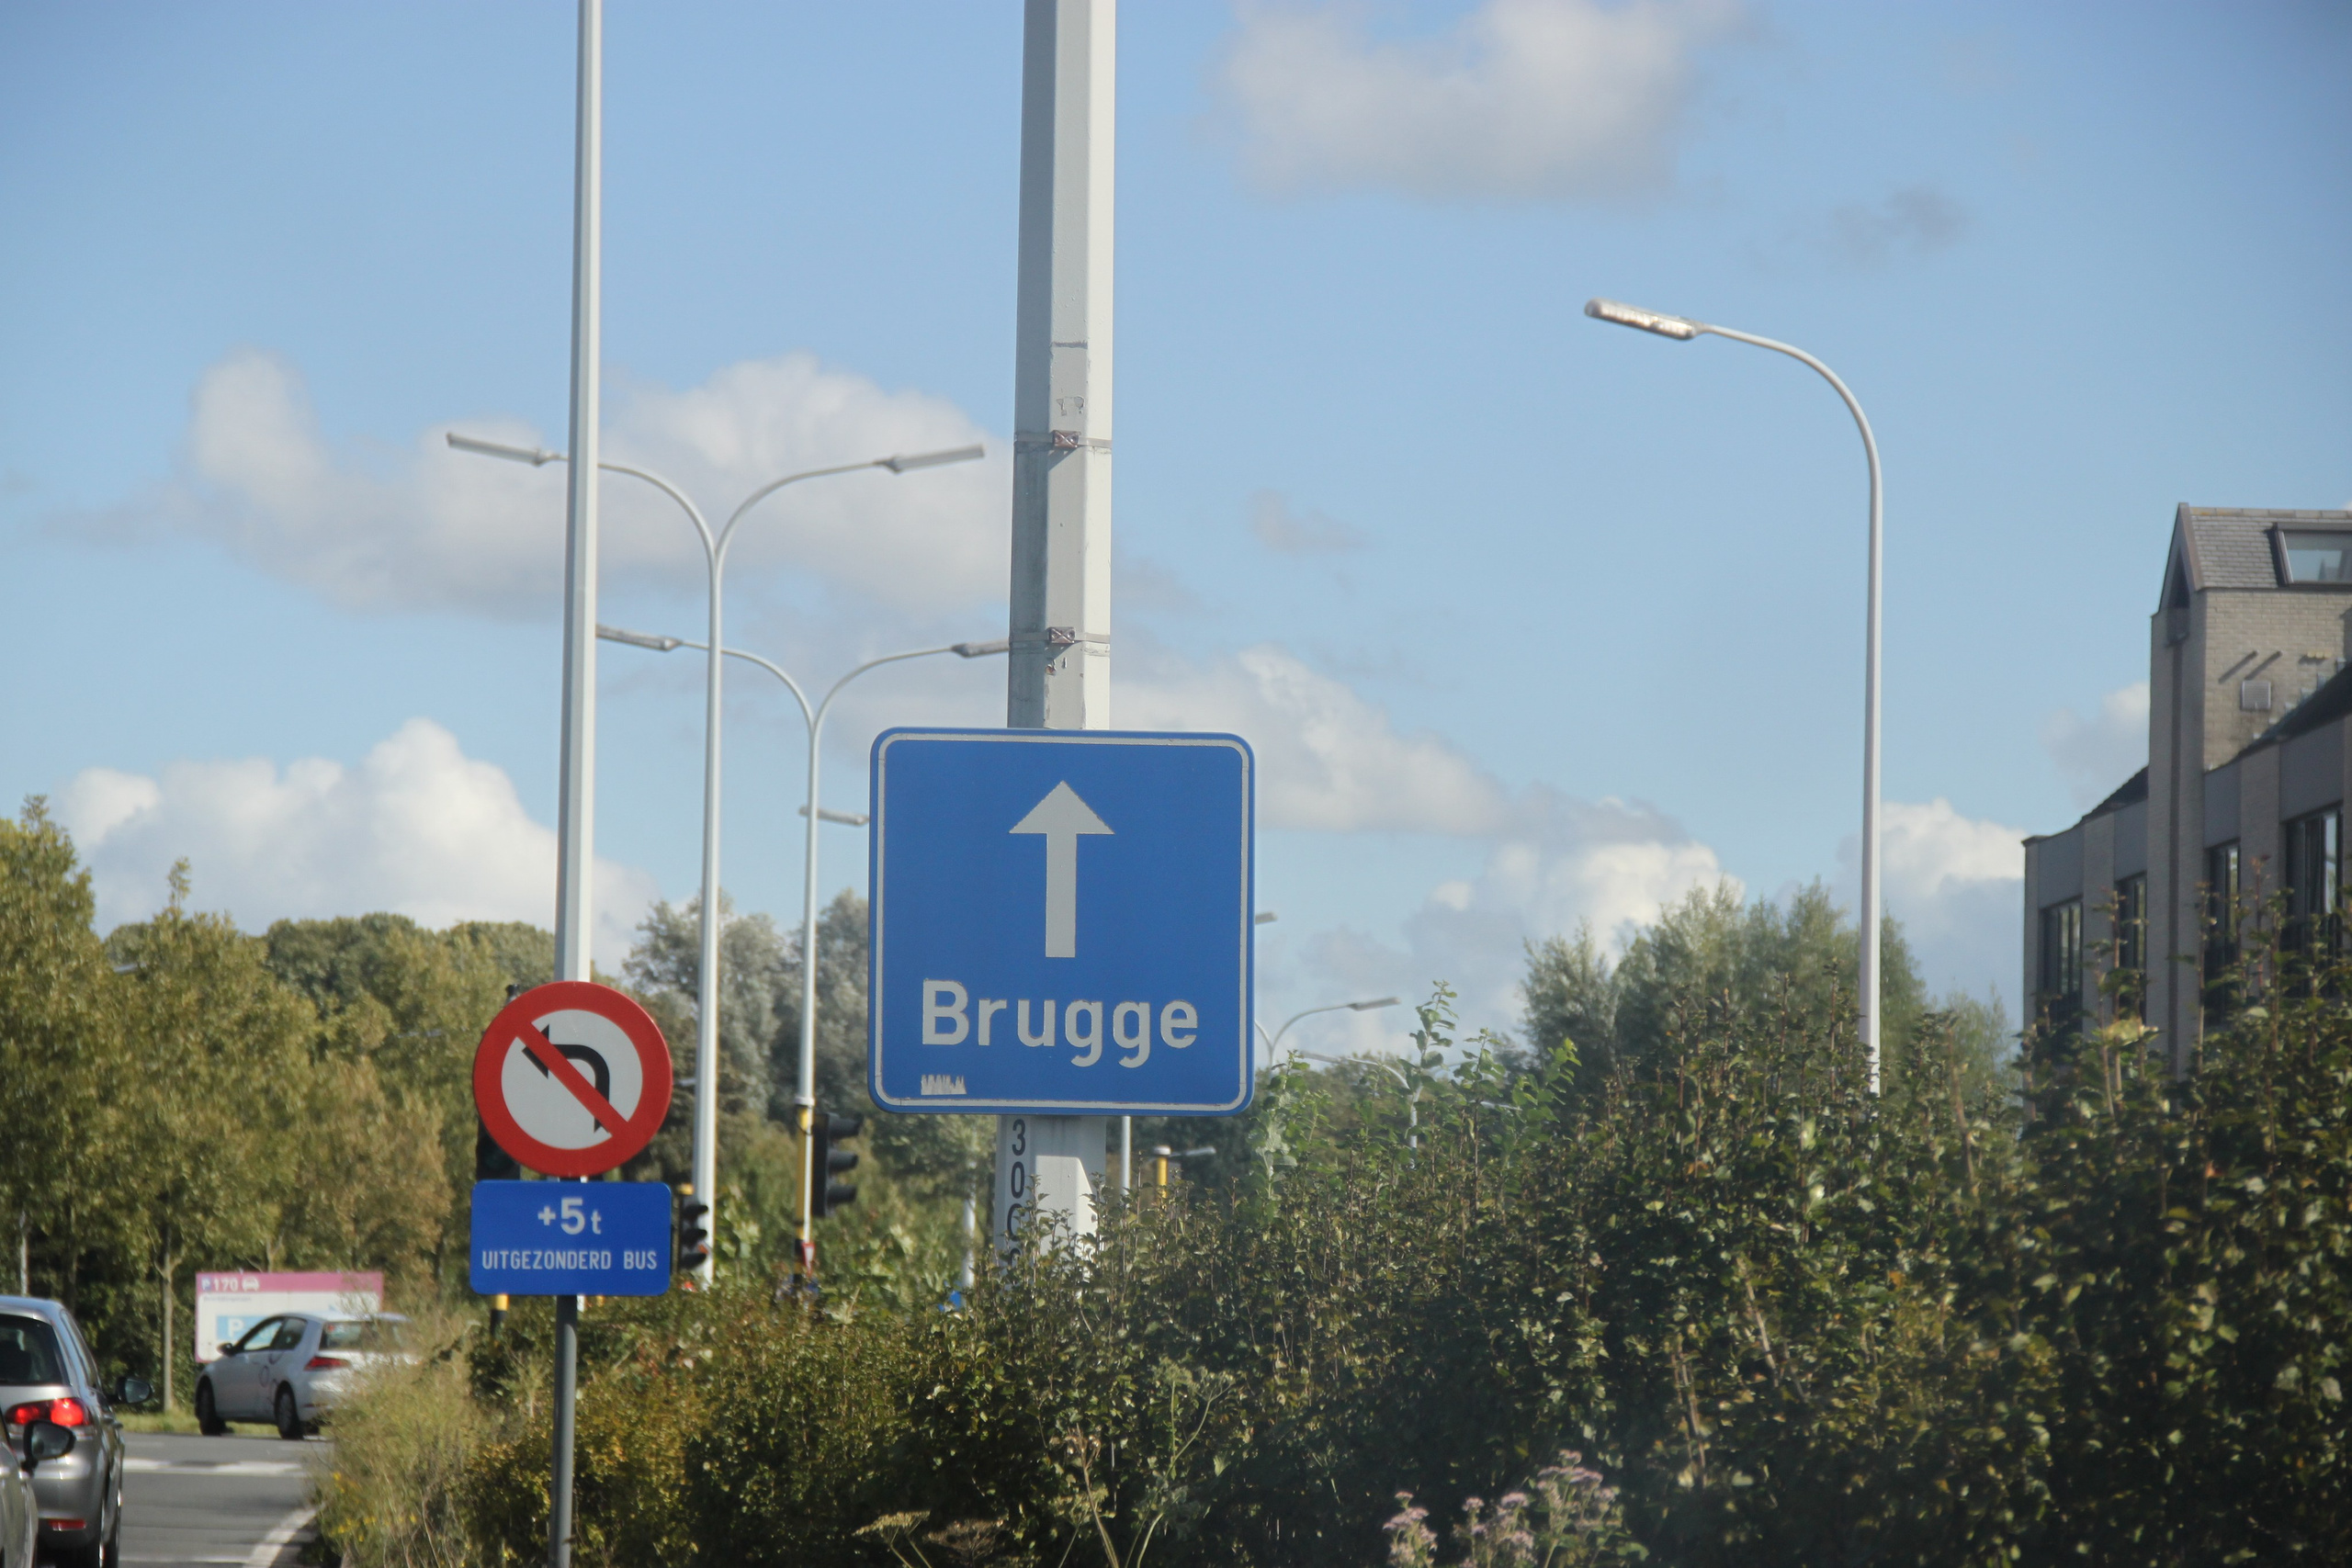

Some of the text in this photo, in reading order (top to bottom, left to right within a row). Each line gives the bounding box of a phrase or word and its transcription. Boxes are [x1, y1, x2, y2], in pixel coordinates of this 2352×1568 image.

[922, 978, 1198, 1068] Brugge
[481, 1250, 658, 1270] UITGEZONDERD BUS
[213, 1277, 239, 1292] 170
